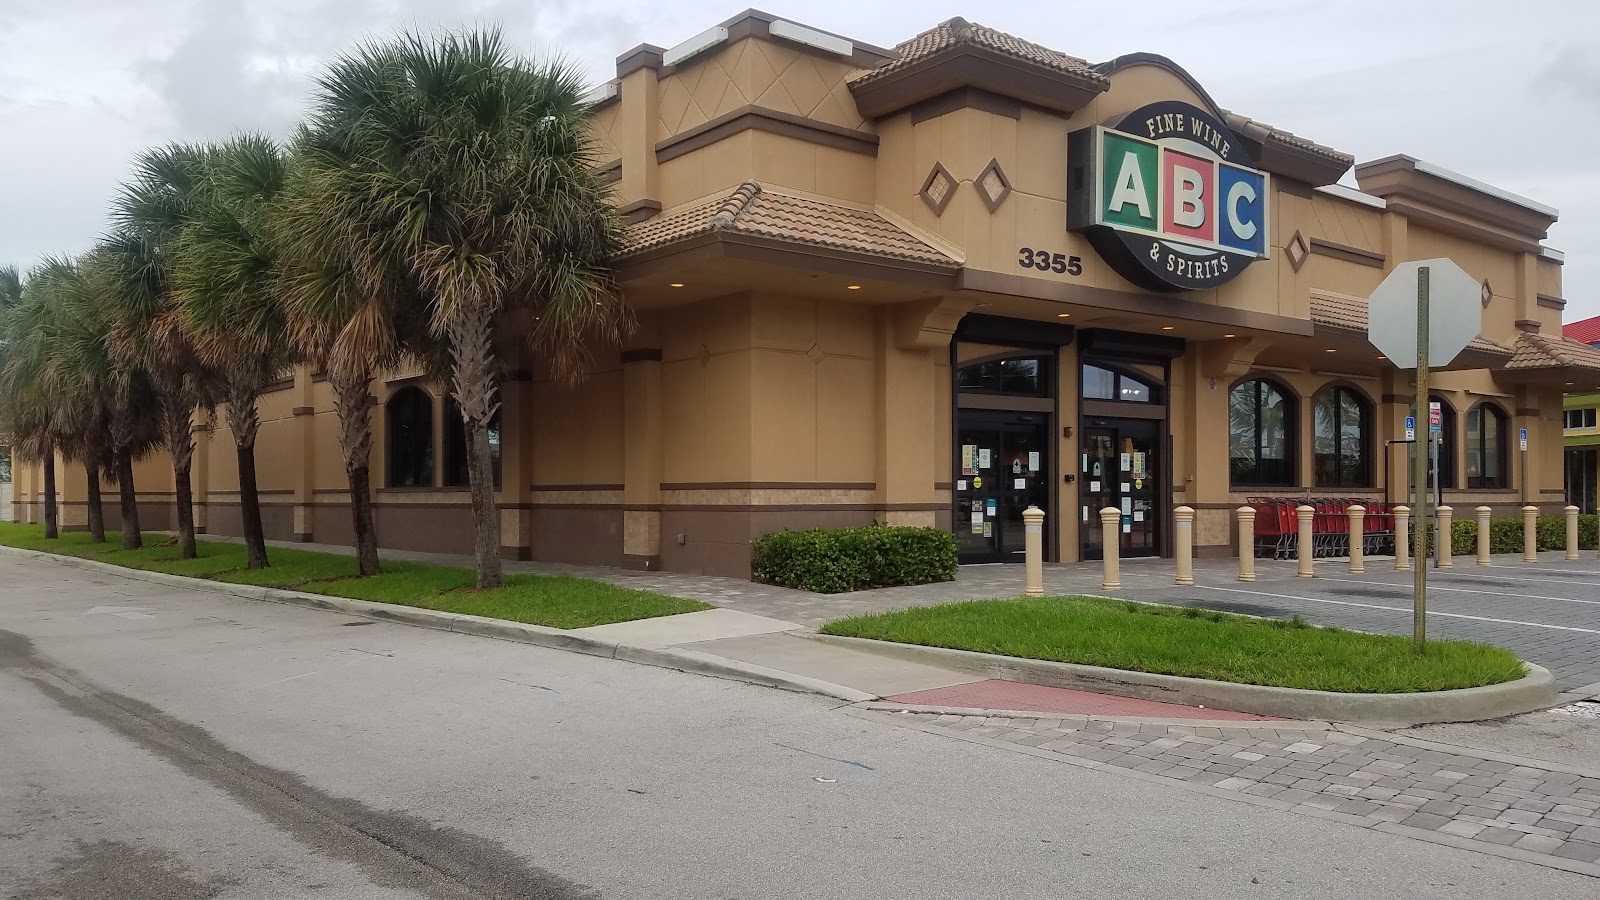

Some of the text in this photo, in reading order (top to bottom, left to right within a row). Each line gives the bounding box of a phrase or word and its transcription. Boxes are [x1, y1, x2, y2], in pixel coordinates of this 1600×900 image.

[1146, 113, 1231, 159] FINE WINE
[1108, 150, 1258, 241] ABC
[1018, 247, 1083, 276] 3355
[1149, 242, 1229, 279] & SPIRITS
